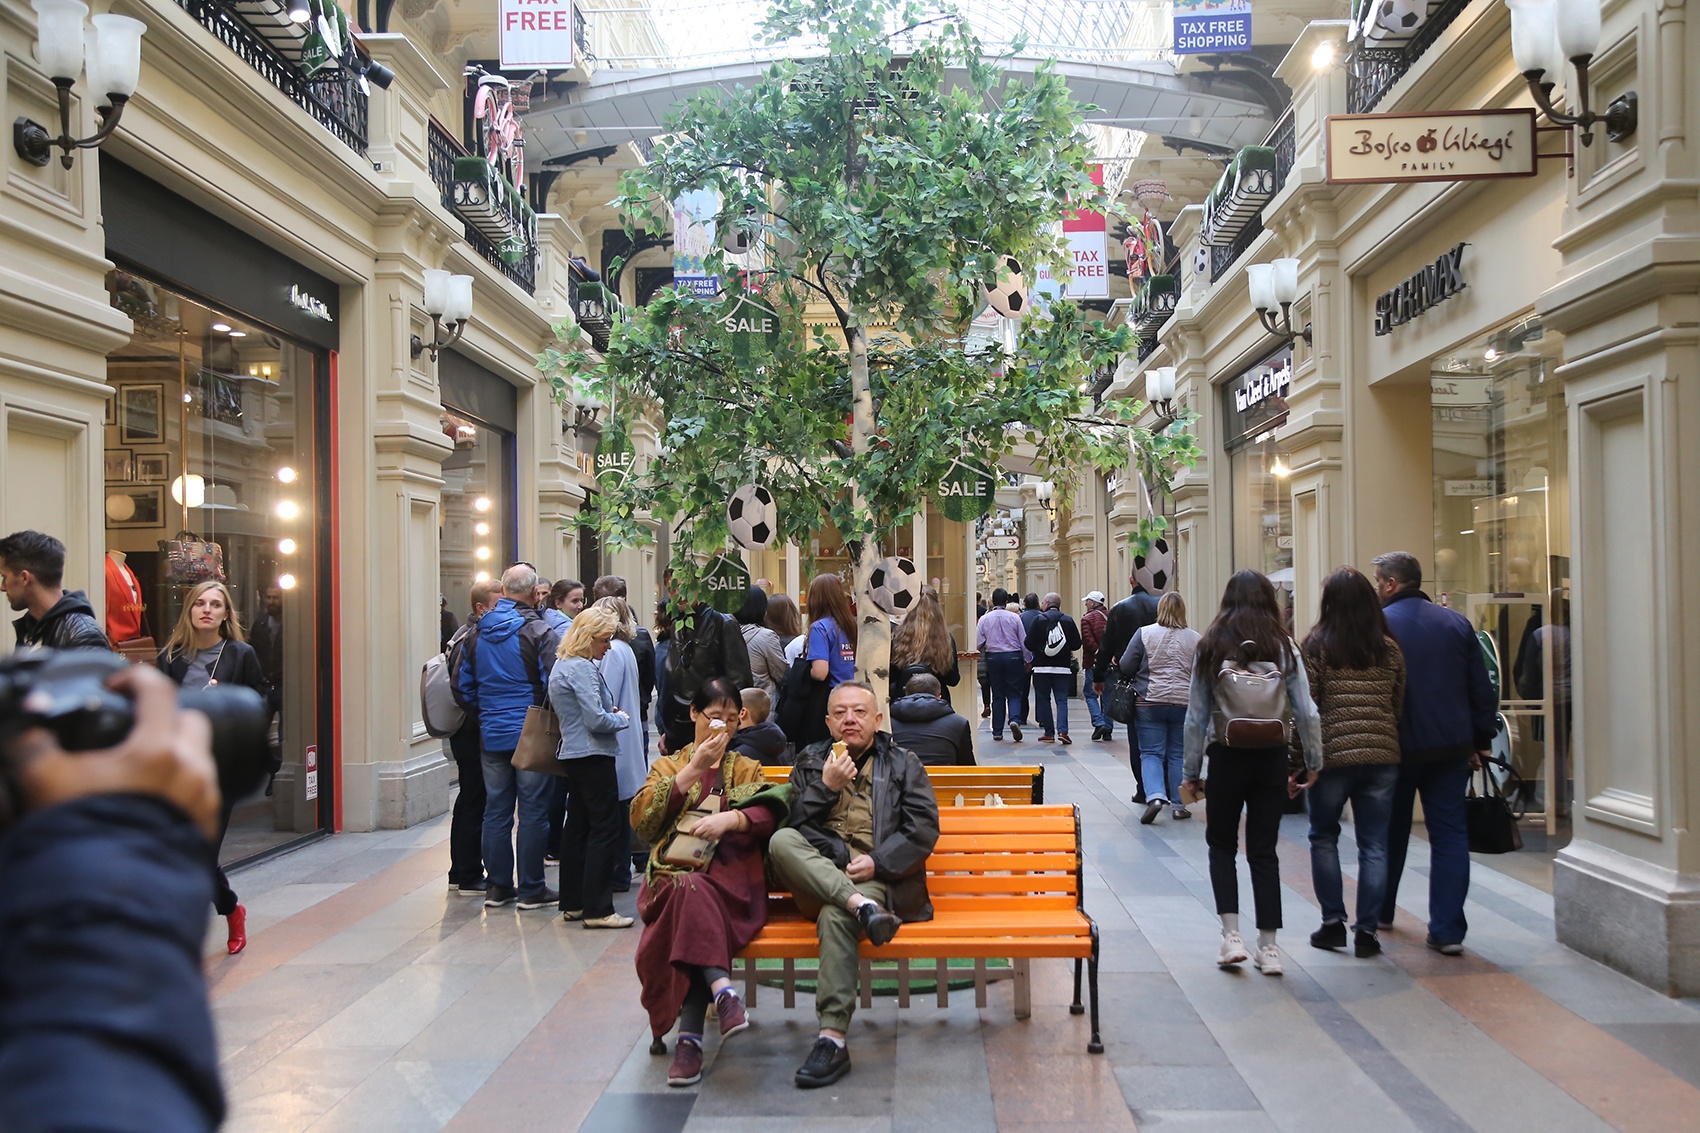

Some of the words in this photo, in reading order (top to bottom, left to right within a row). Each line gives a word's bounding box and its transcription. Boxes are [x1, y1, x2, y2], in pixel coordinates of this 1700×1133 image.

[506, 11, 567, 31] FREE
[1180, 22, 1206, 35] TAX
[1209, 19, 1244, 33] FREE
[1178, 34, 1247, 48] SHOPPING
[302, 46, 323, 62] SALE
[1401, 161, 1456, 171] FAMILY
[501, 244, 523, 253] SALE
[1072, 250, 1099, 262] TAX
[693, 279, 714, 288] FREE
[1375, 242, 1467, 336] SPORTMAX
[725, 317, 773, 333] SALE
[1235, 388, 1247, 413] Van
[1247, 373, 1263, 407] Cleef
[1263, 376, 1270, 397] &
[597, 451, 630, 468] SALE
[938, 480, 986, 497] SALE
[707, 575, 746, 590] SALE
